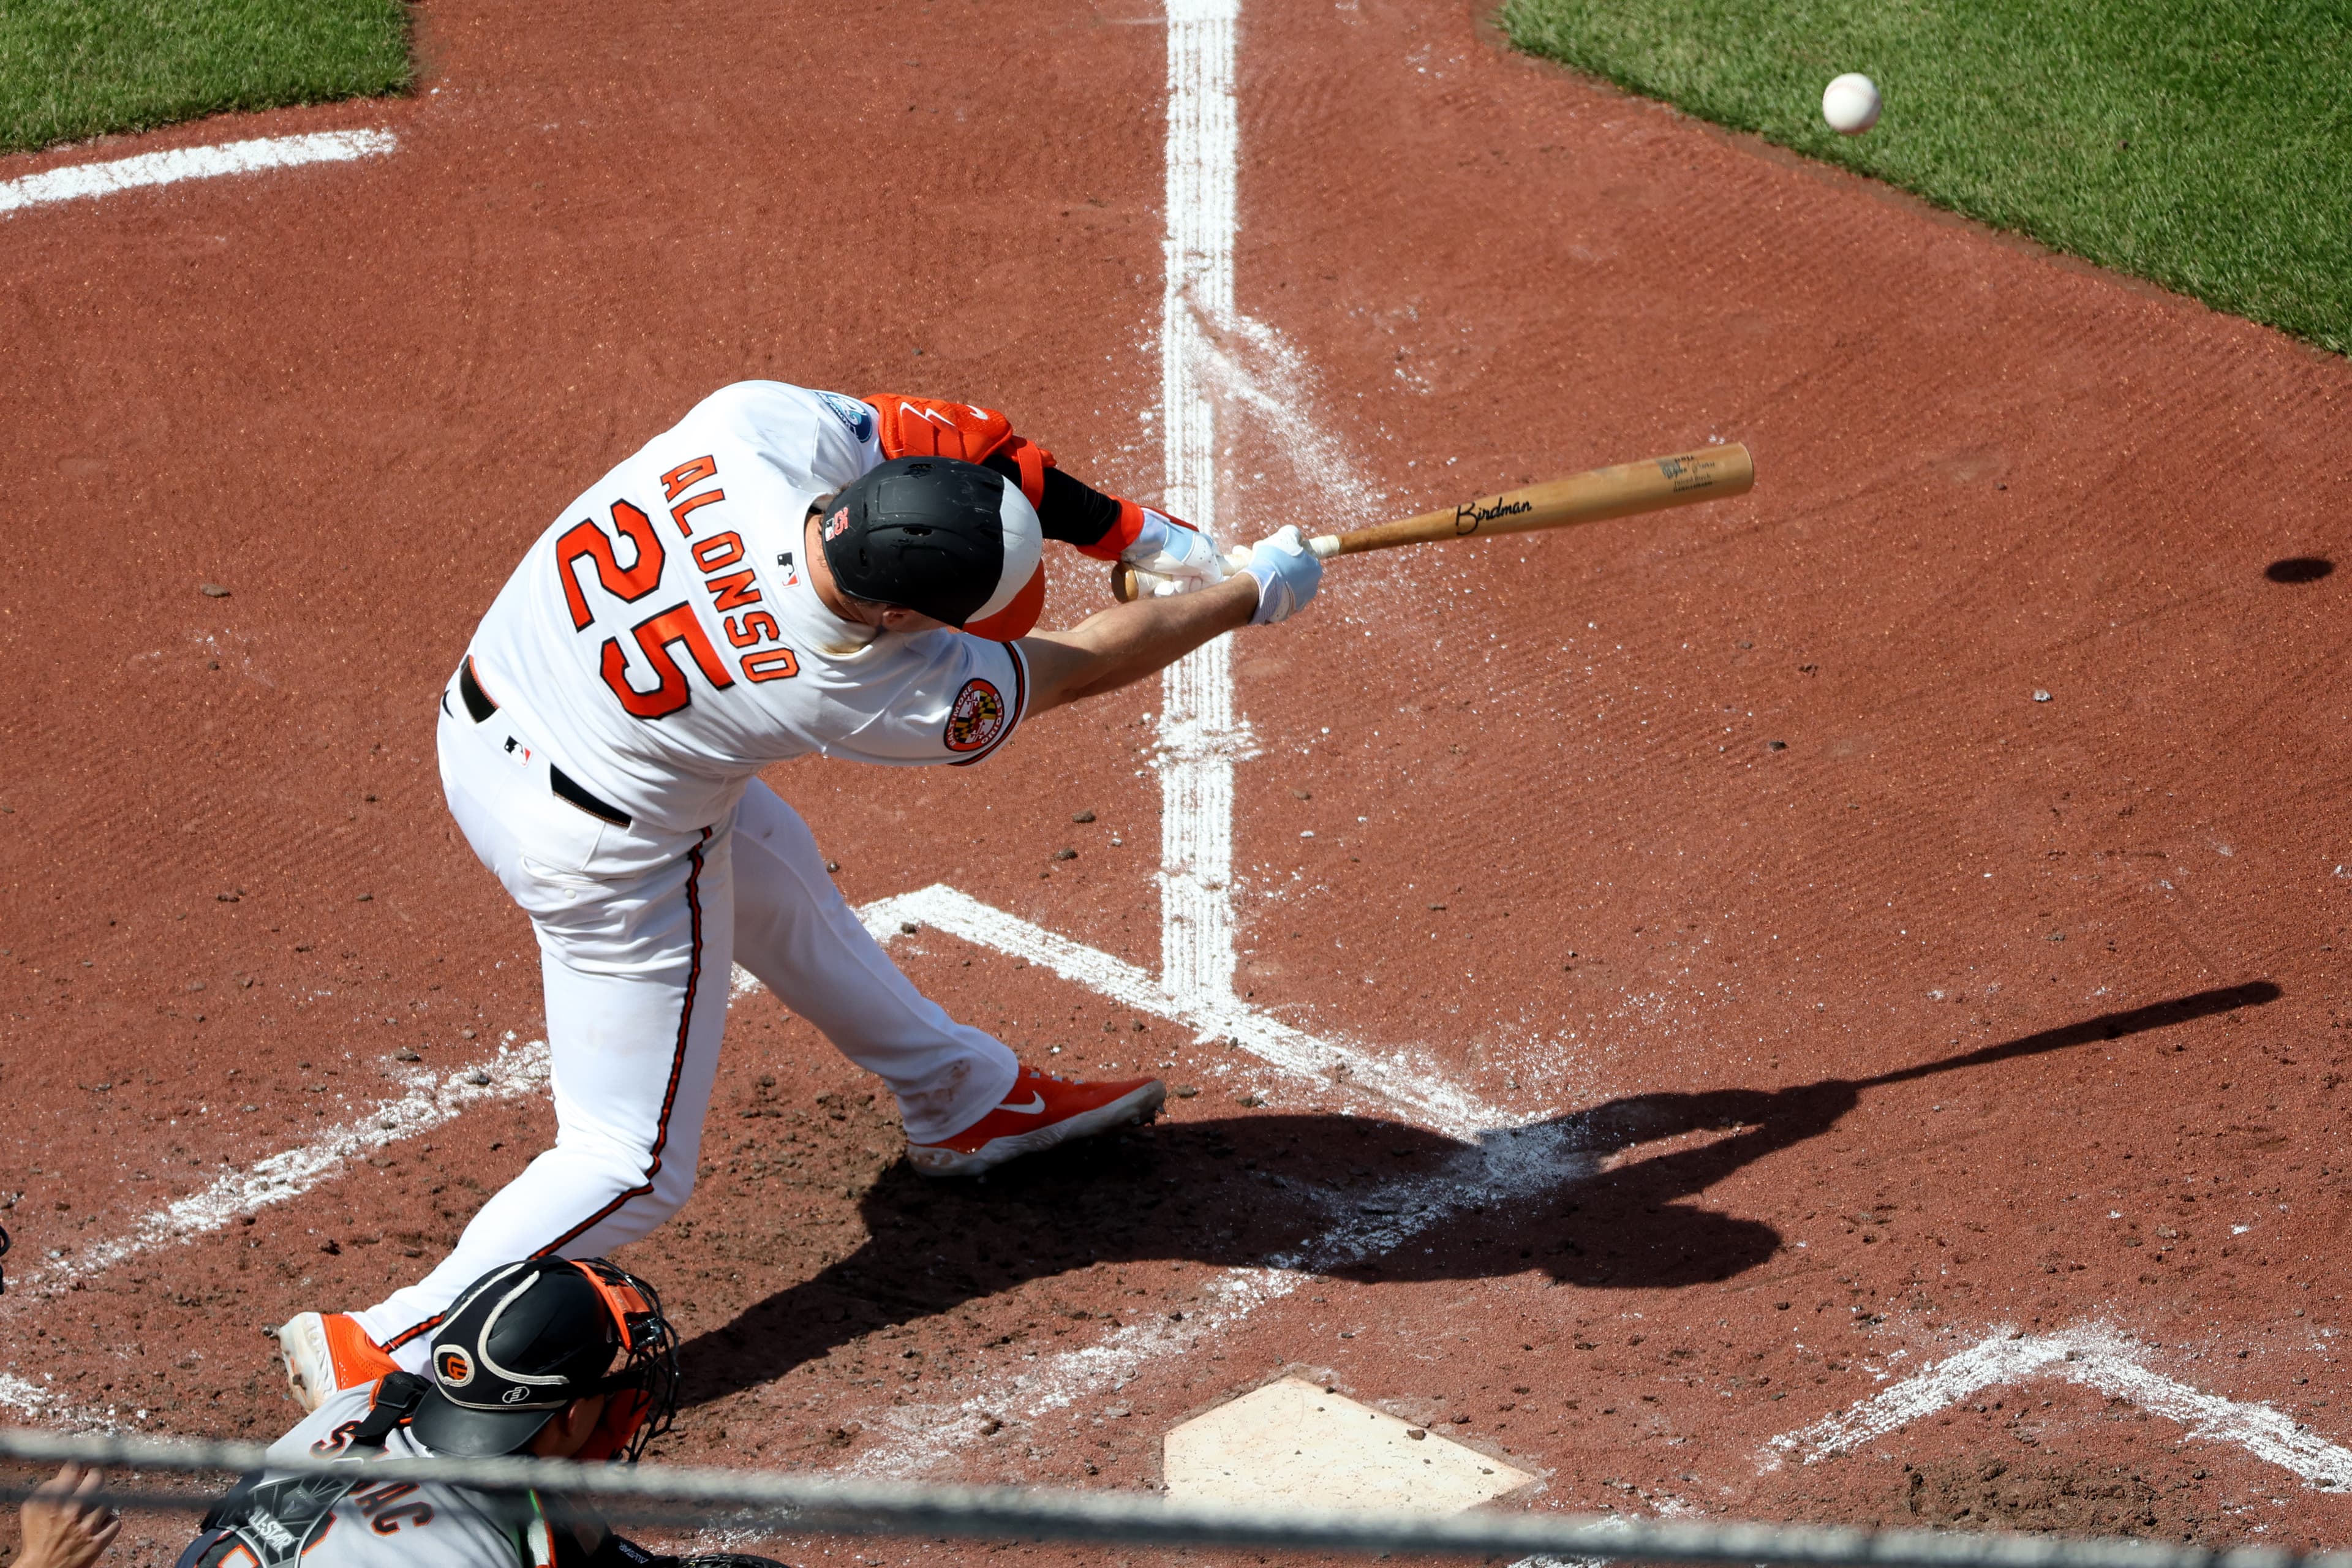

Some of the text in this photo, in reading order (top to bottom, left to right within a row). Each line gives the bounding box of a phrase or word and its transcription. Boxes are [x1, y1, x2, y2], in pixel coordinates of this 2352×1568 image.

[834, 507, 849, 535] 25
[1455, 496, 1532, 536] Birdman
[660, 454, 800, 683] ALONSO
[556, 498, 736, 720] 25
[948, 684, 973, 747] BALTIMORE
[981, 693, 1003, 745] ORIOLES
[309, 1420, 435, 1537] SAC
